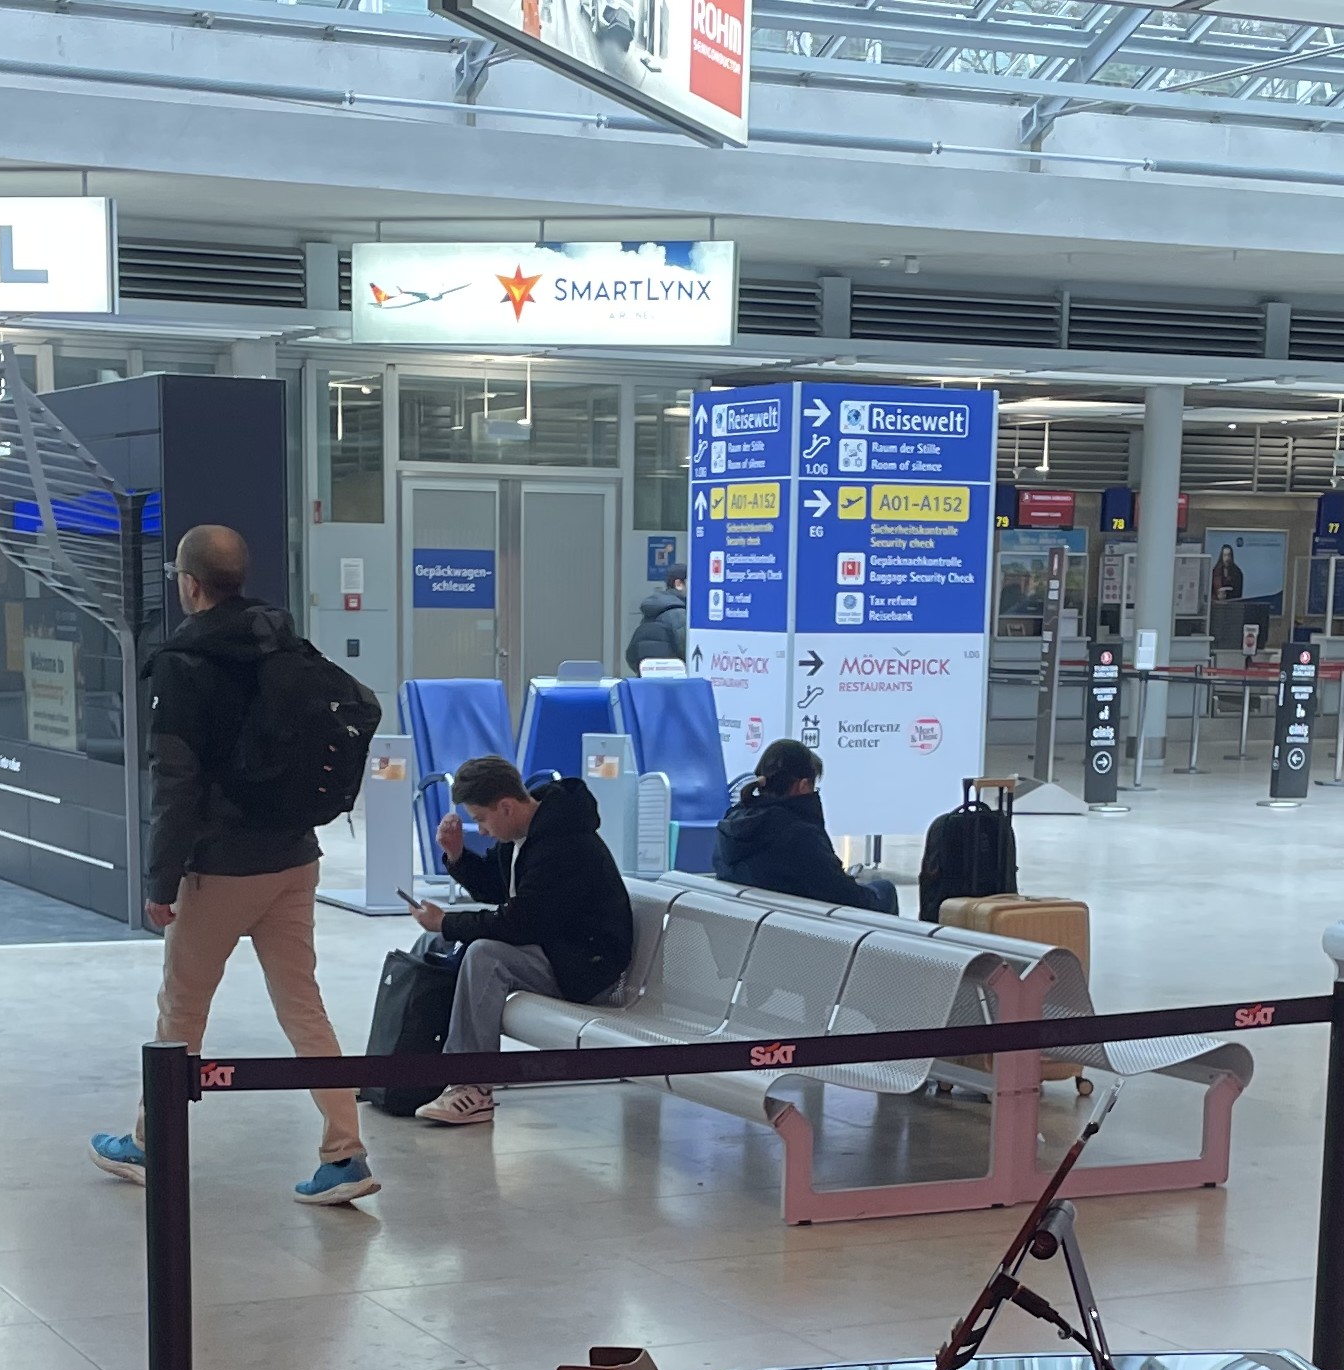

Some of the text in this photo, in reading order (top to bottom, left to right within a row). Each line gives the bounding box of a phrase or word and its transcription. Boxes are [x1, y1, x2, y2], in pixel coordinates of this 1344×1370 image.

[693, 0, 742, 55] ROHM
[728, 405, 778, 431] Reisewelt
[872, 407, 965, 433] Reisewelt
[871, 441, 941, 455] Raum der Stille
[871, 459, 943, 472] Room of silence
[878, 494, 963, 513] A01-A152
[996, 515, 1010, 528] 79
[809, 525, 825, 538] EG
[869, 536, 935, 550] Security check
[415, 564, 492, 580] Gepäckwagen-
[869, 571, 975, 585] Baggage Security Check
[431, 580, 476, 592] schleuse
[869, 595, 918, 607] Tax refund
[868, 610, 913, 622] Reisebank
[839, 654, 951, 676] MÖVENPICK
[838, 681, 913, 693] RESTAURANTS
[837, 719, 901, 734] Konferenz
[837, 735, 881, 749] Center
